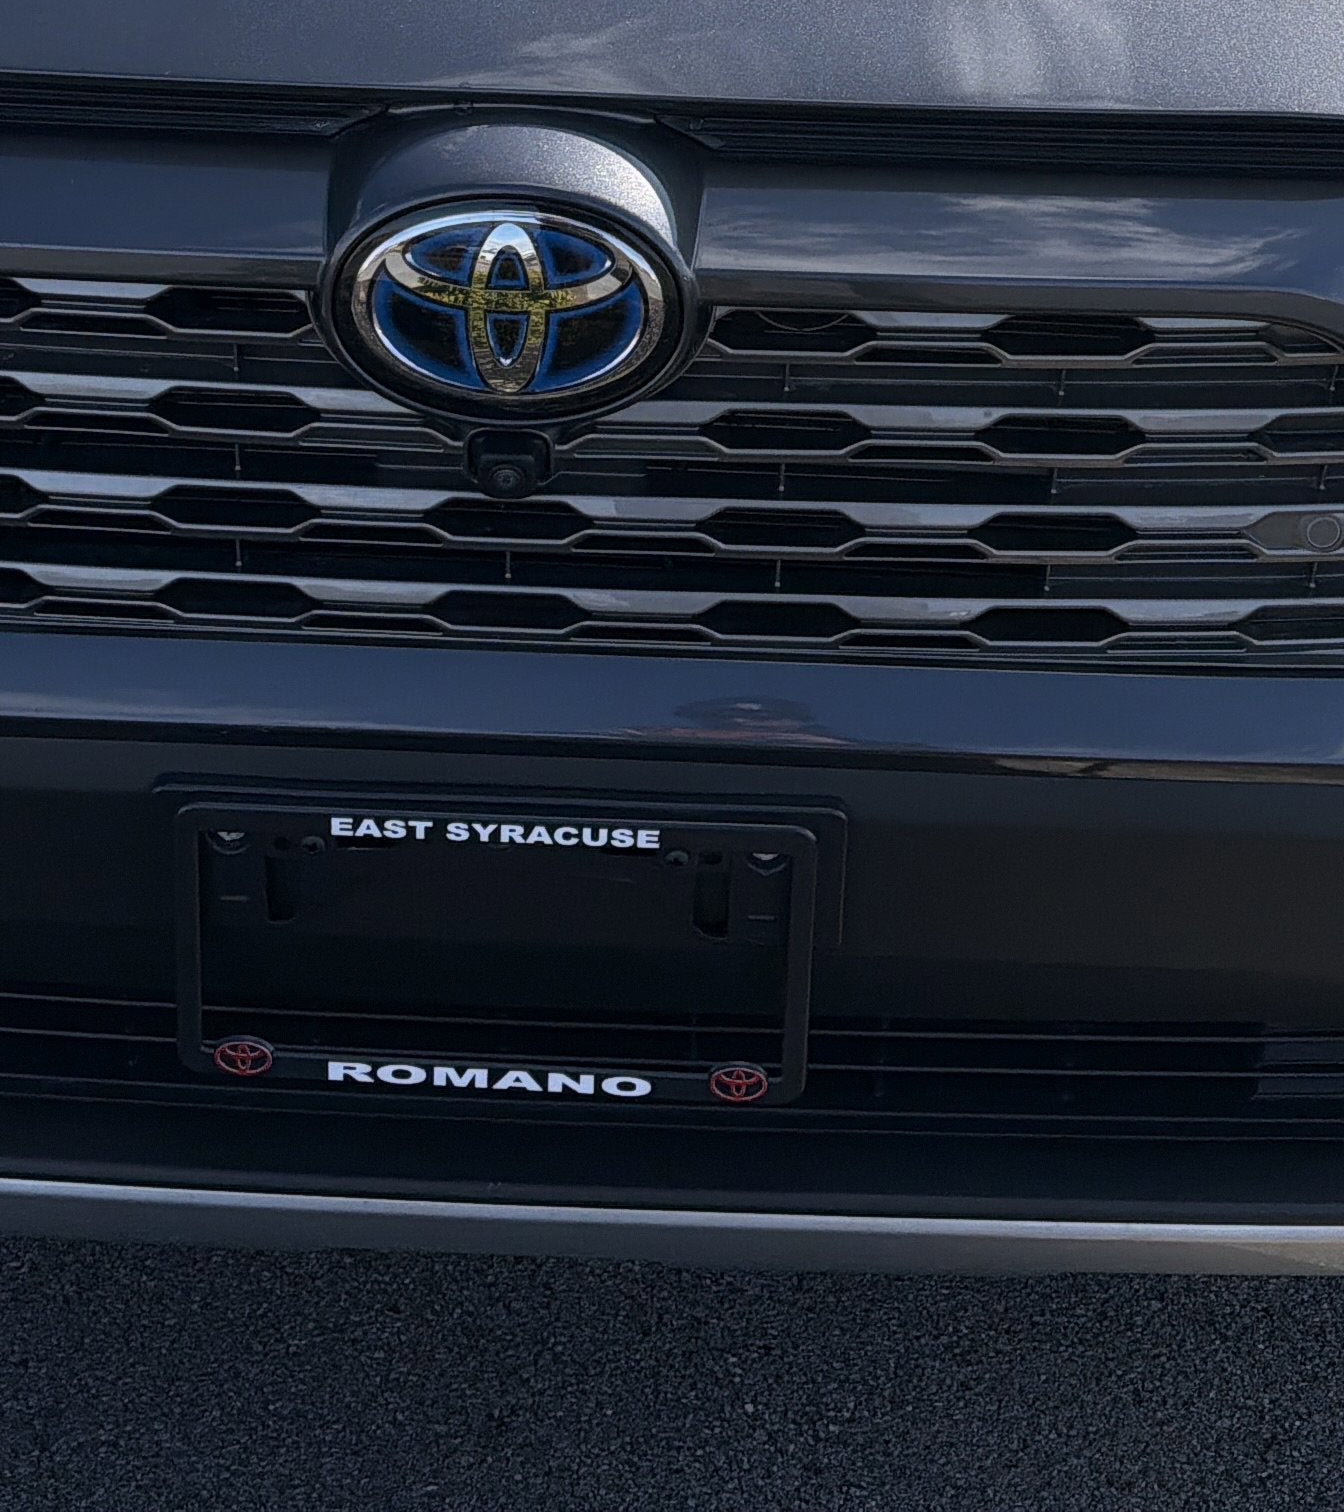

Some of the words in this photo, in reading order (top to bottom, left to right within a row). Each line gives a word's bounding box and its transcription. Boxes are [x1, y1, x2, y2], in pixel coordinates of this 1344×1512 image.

[330, 817, 434, 839] EAST
[445, 822, 661, 849] SYRACUSE
[327, 1061, 652, 1097] ROMANO
